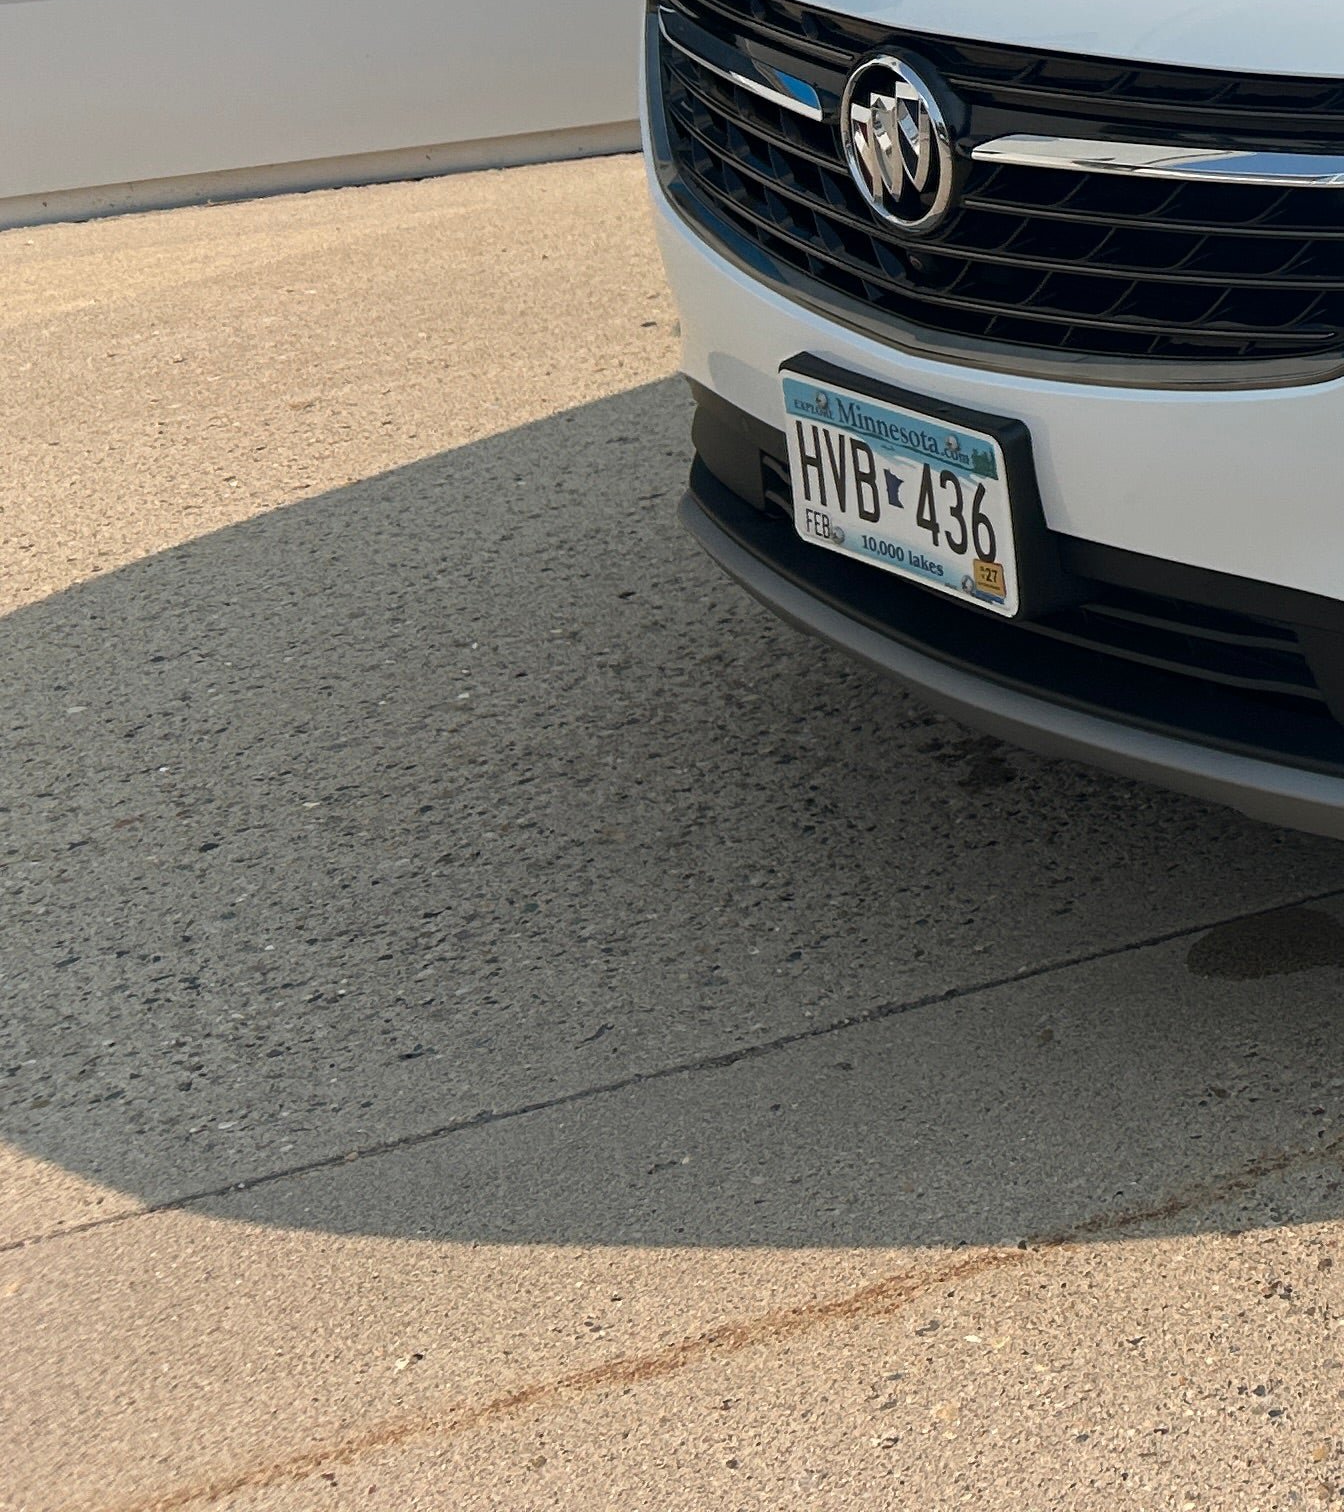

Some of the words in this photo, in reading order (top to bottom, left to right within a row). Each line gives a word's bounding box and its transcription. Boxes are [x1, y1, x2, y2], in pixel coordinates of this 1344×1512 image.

[796, 420, 880, 524] HVB
[916, 462, 997, 564] 436
[805, 508, 831, 539] FEB
[861, 534, 905, 562] 10,000
[908, 549, 945, 577] lakes
[984, 567, 999, 584] 27
